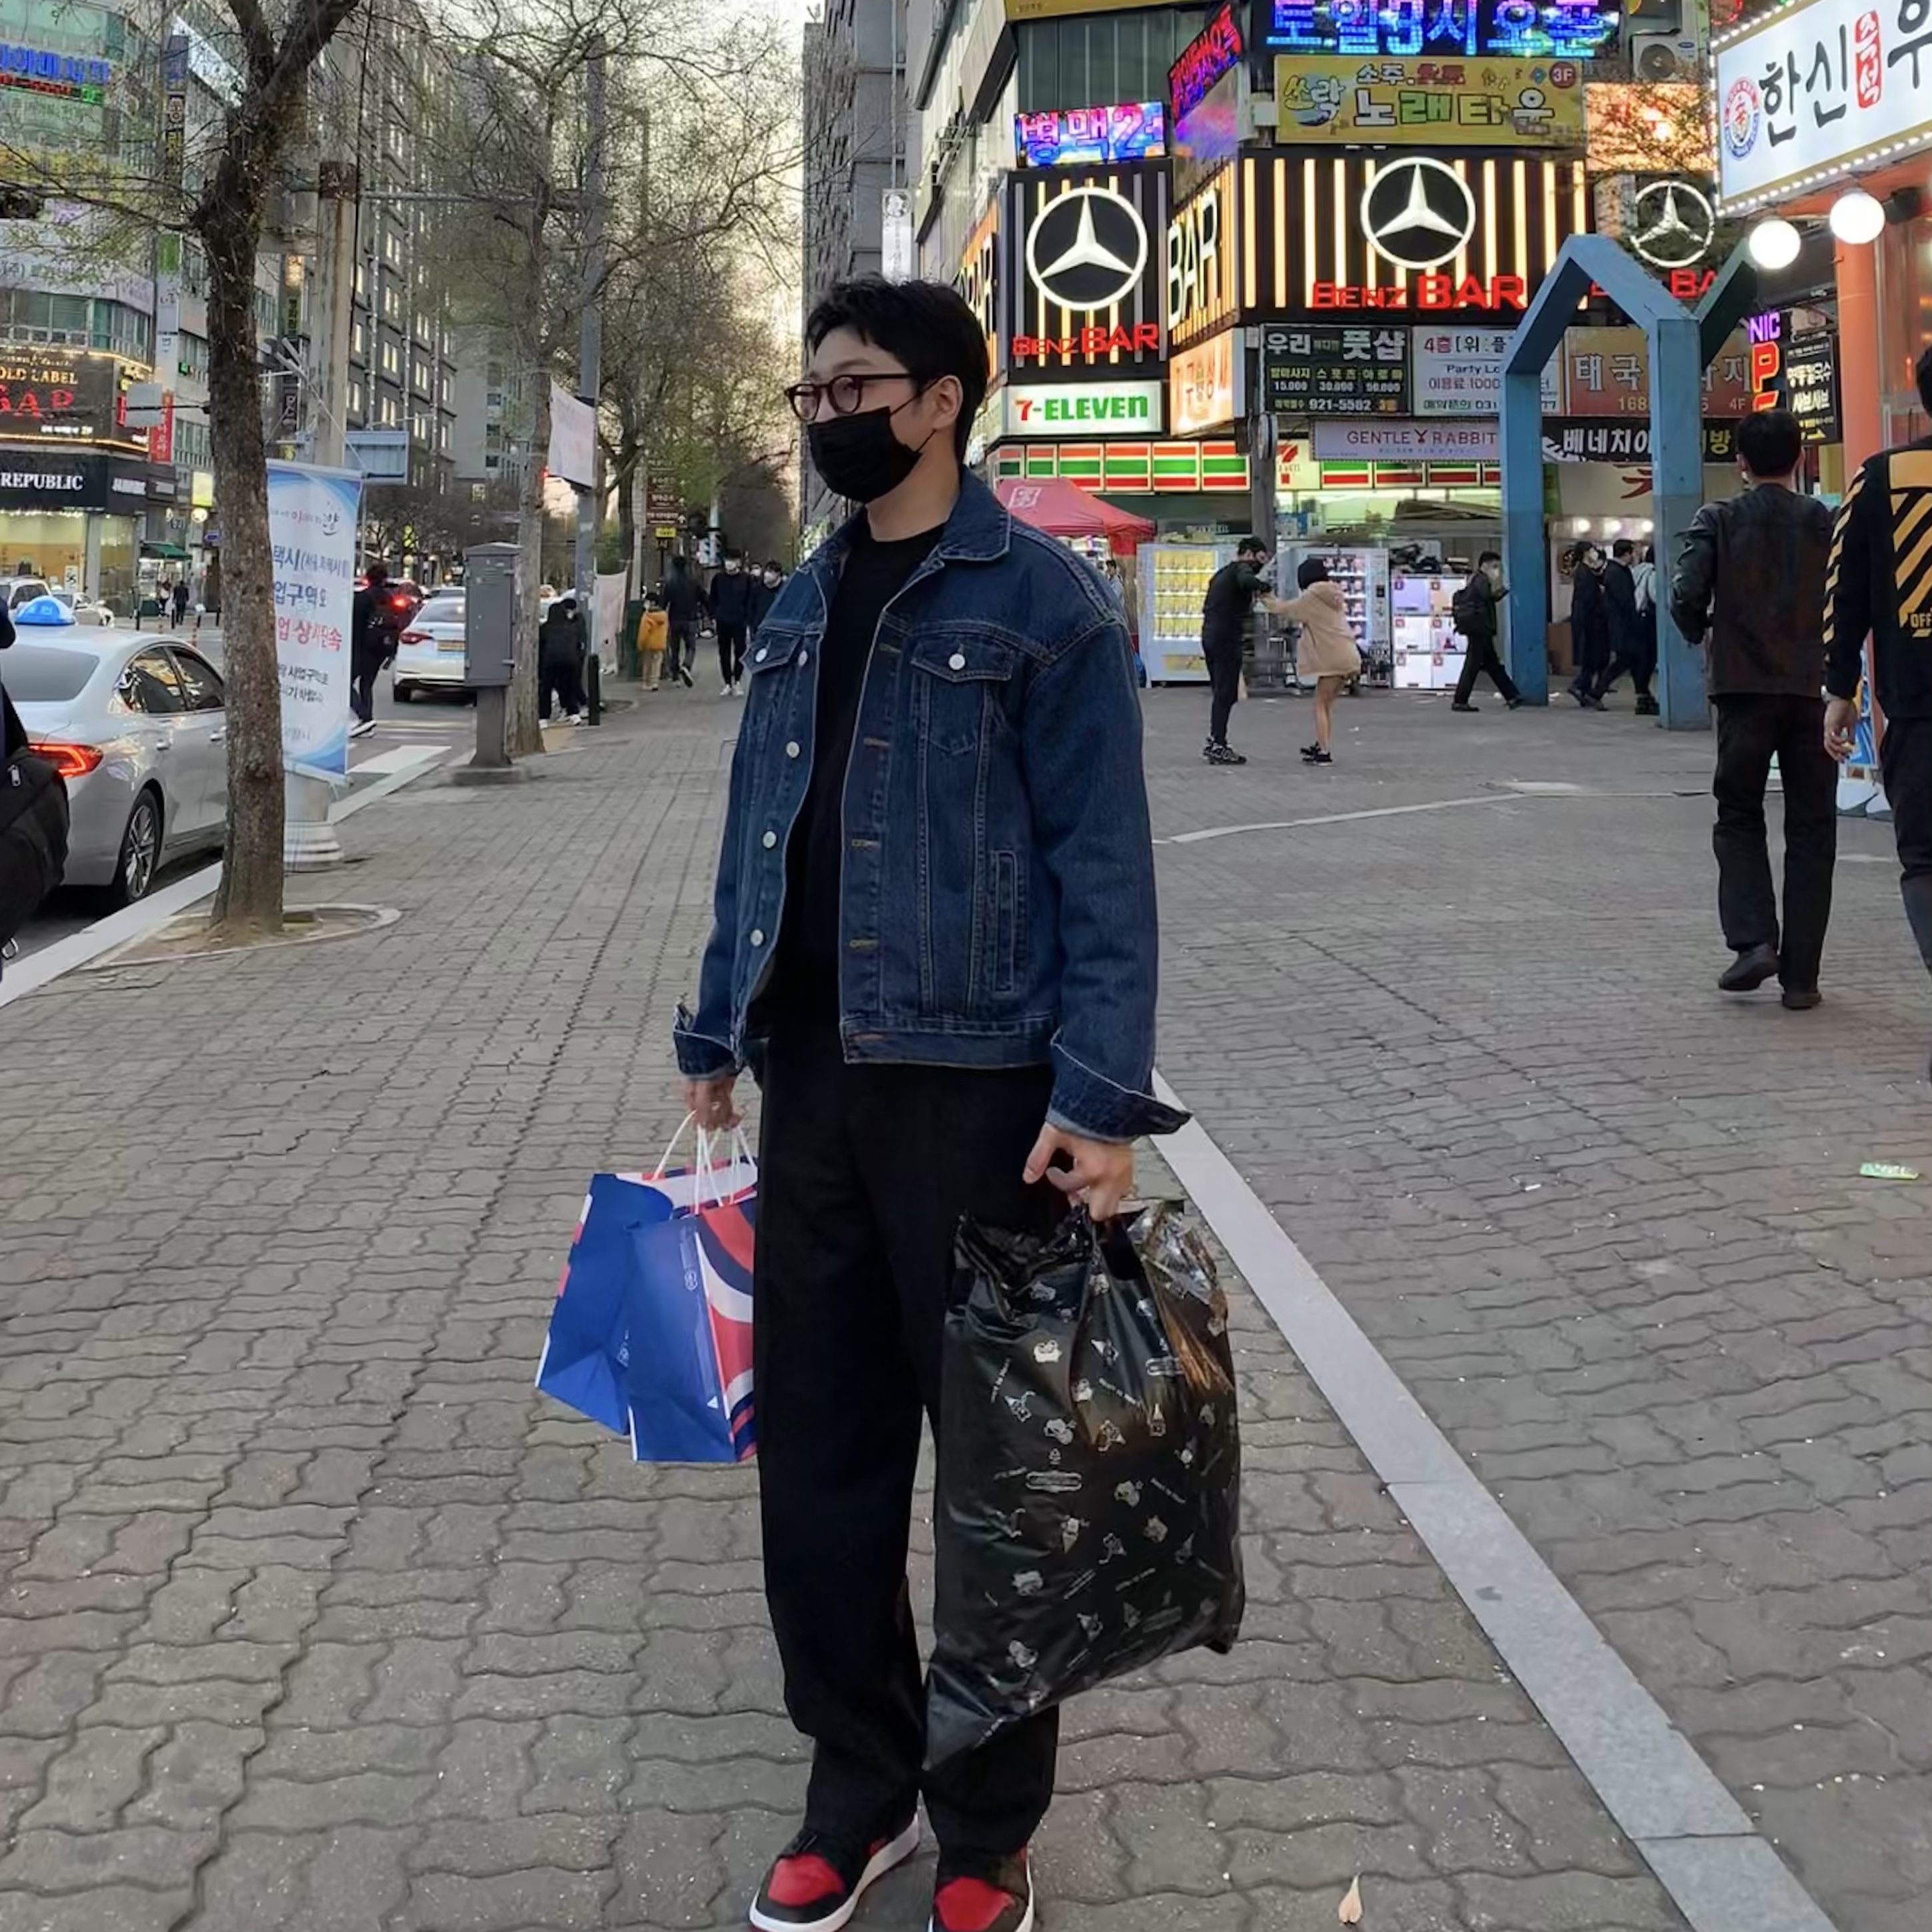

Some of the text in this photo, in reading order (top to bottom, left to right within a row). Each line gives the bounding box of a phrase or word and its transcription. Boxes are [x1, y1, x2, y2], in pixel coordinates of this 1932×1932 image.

[1759, 23, 1847, 147] 한신
[1167, 188, 1219, 332] BAR
[1417, 274, 1527, 310] BAR
[1081, 323, 1159, 353] BAR
[1267, 332, 1311, 355] 우리
[1343, 330, 1405, 361] 풋샵
[1347, 431, 1411, 445] GENTLE
[1, 472, 83, 491] REPUBLIC
